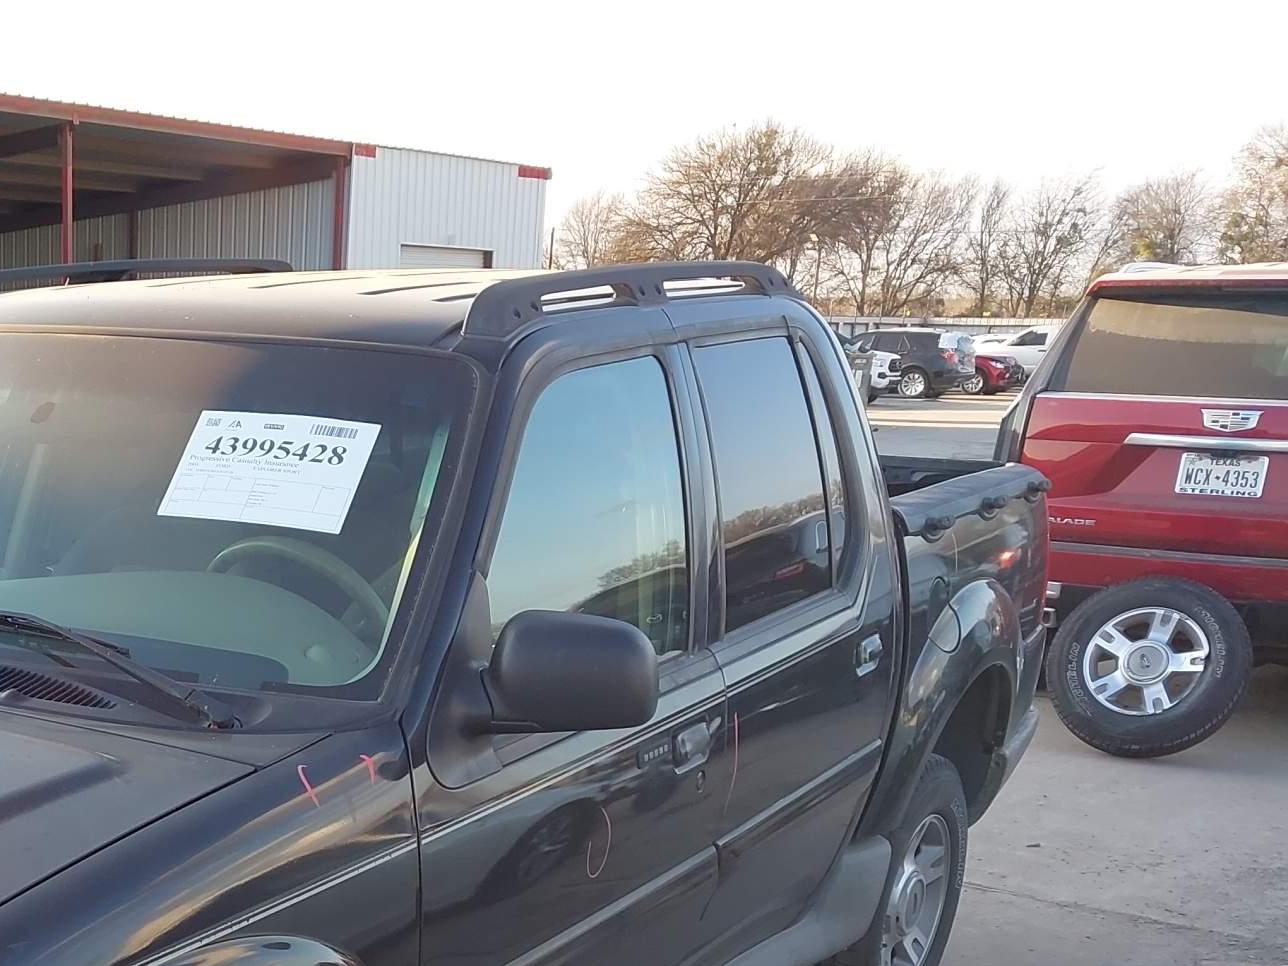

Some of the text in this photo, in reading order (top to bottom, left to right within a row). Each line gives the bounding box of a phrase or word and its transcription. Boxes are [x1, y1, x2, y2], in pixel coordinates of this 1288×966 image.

[205, 435, 347, 466] 43995428
[1210, 458, 1241, 467] TEXAS
[1179, 487, 1259, 497] STERLING
[1048, 516, 1096, 526] ALADE
